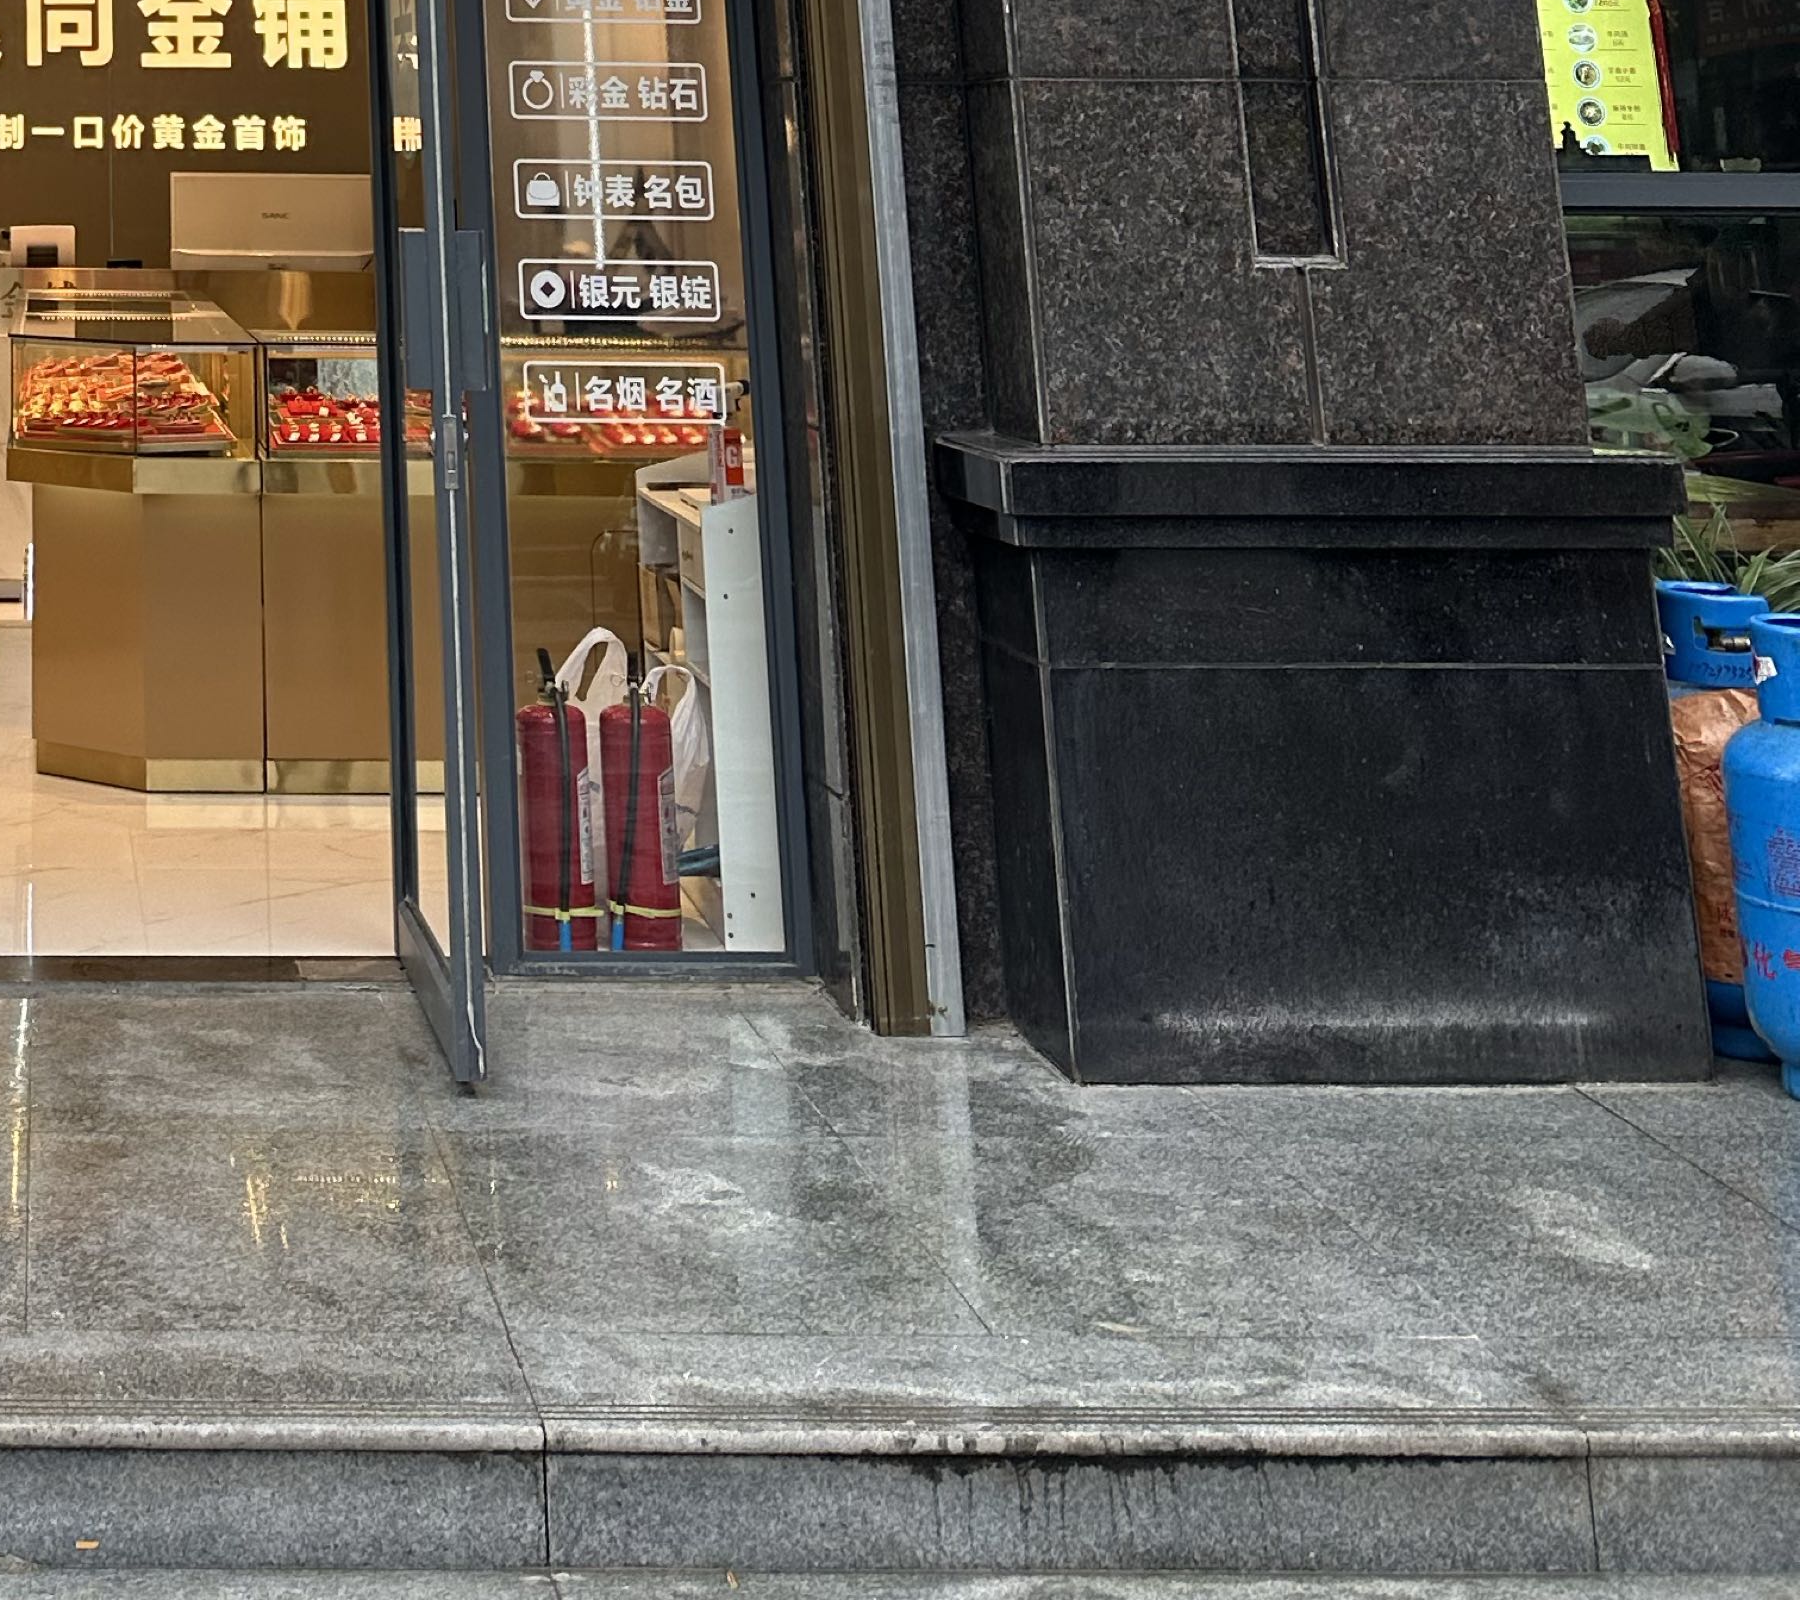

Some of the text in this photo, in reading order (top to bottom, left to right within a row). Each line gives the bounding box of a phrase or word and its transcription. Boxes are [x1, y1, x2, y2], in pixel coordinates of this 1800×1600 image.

[637, 76, 698, 111] 钻石
[573, 173, 707, 210] 钟表 名包
[578, 273, 713, 311] 银元 银锭
[583, 374, 719, 413] 名烟 名酒
